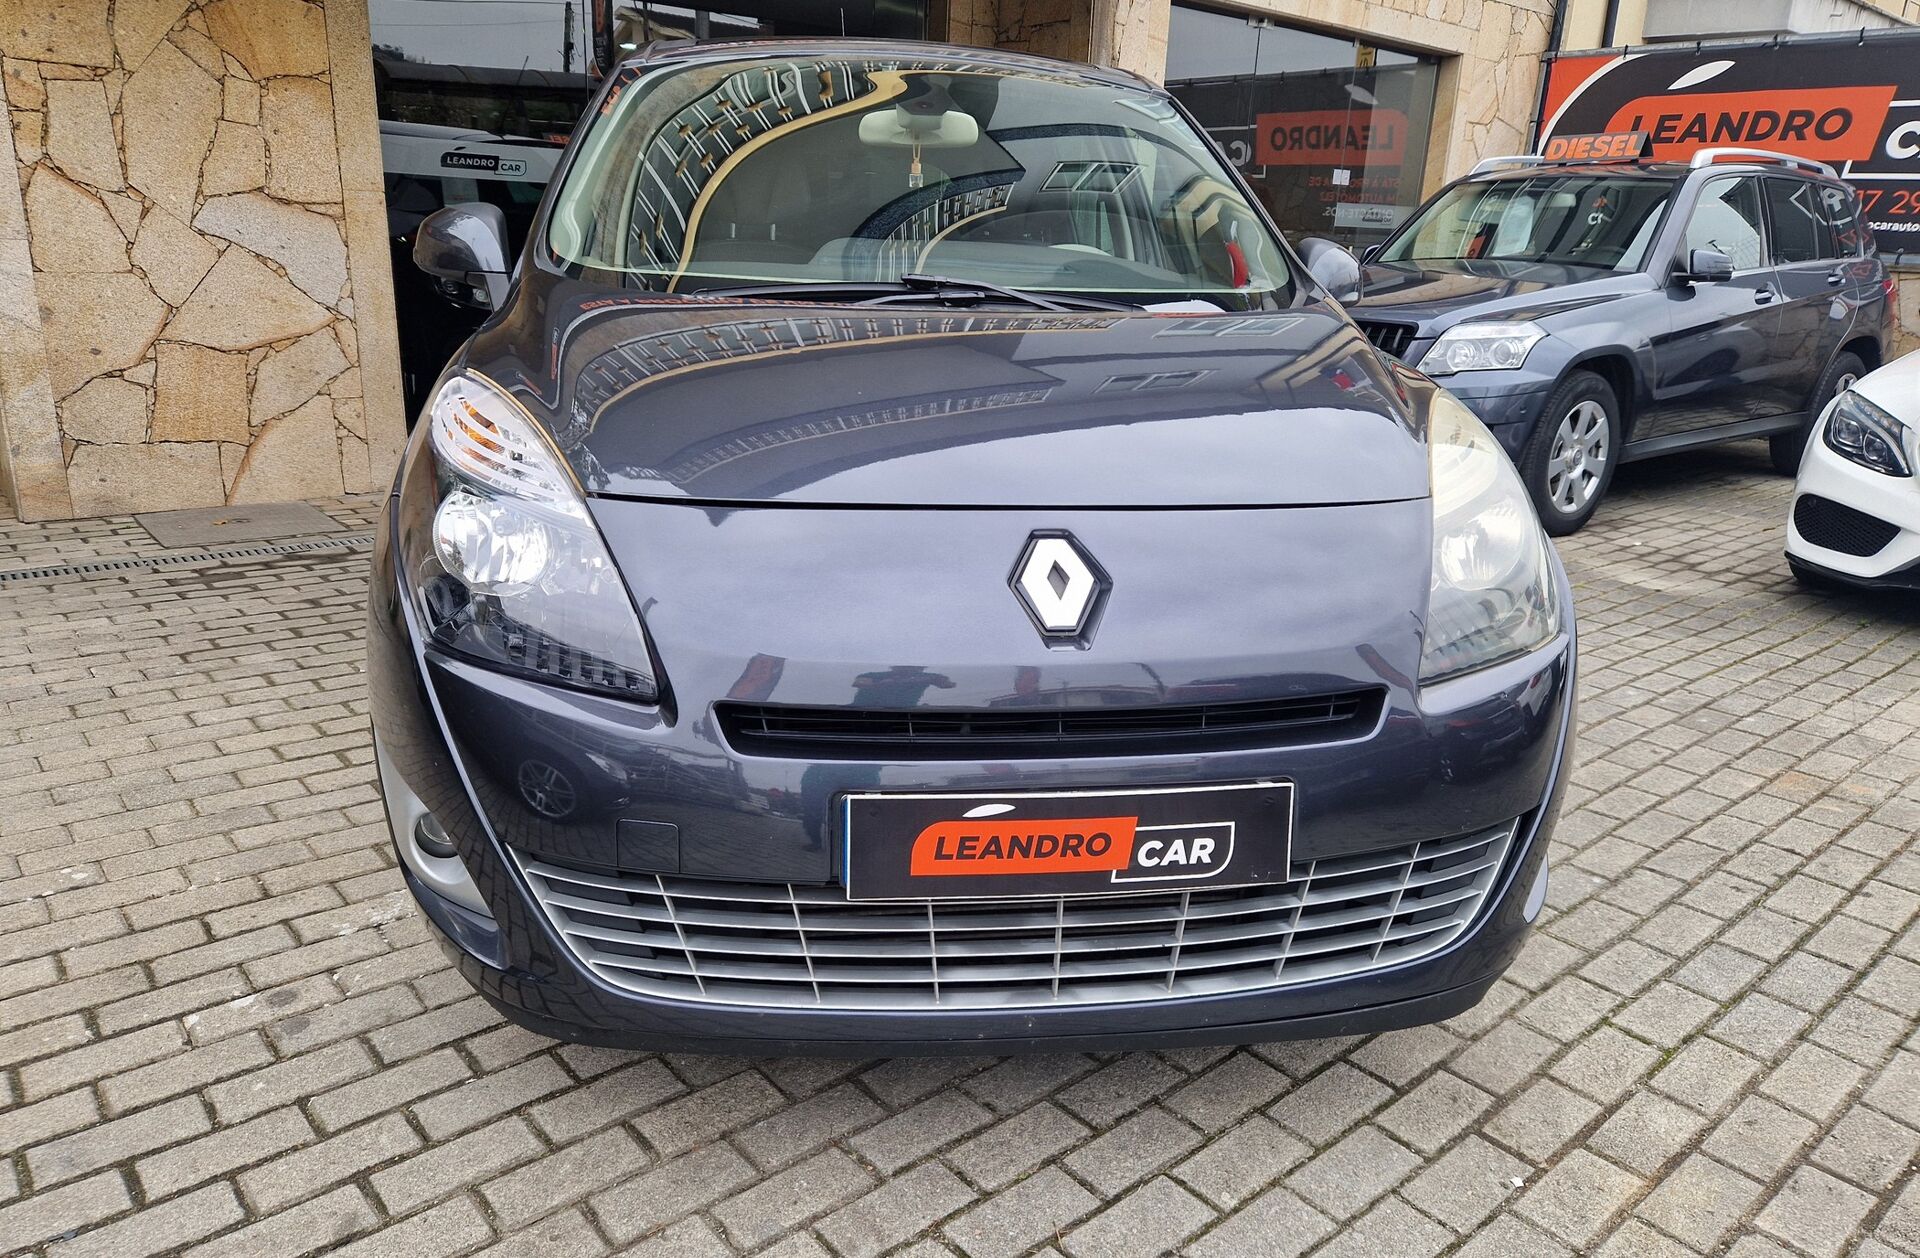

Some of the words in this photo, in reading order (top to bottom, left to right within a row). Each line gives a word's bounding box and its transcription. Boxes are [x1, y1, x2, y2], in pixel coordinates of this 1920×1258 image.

[1546, 135, 1640, 160] DIESEL
[1885, 120, 1920, 159] C
[446, 155, 495, 167] LEANDRO
[500, 163, 521, 172] CAR
[933, 831, 1113, 861] LEANDRO
[1136, 837, 1217, 868] CAR
